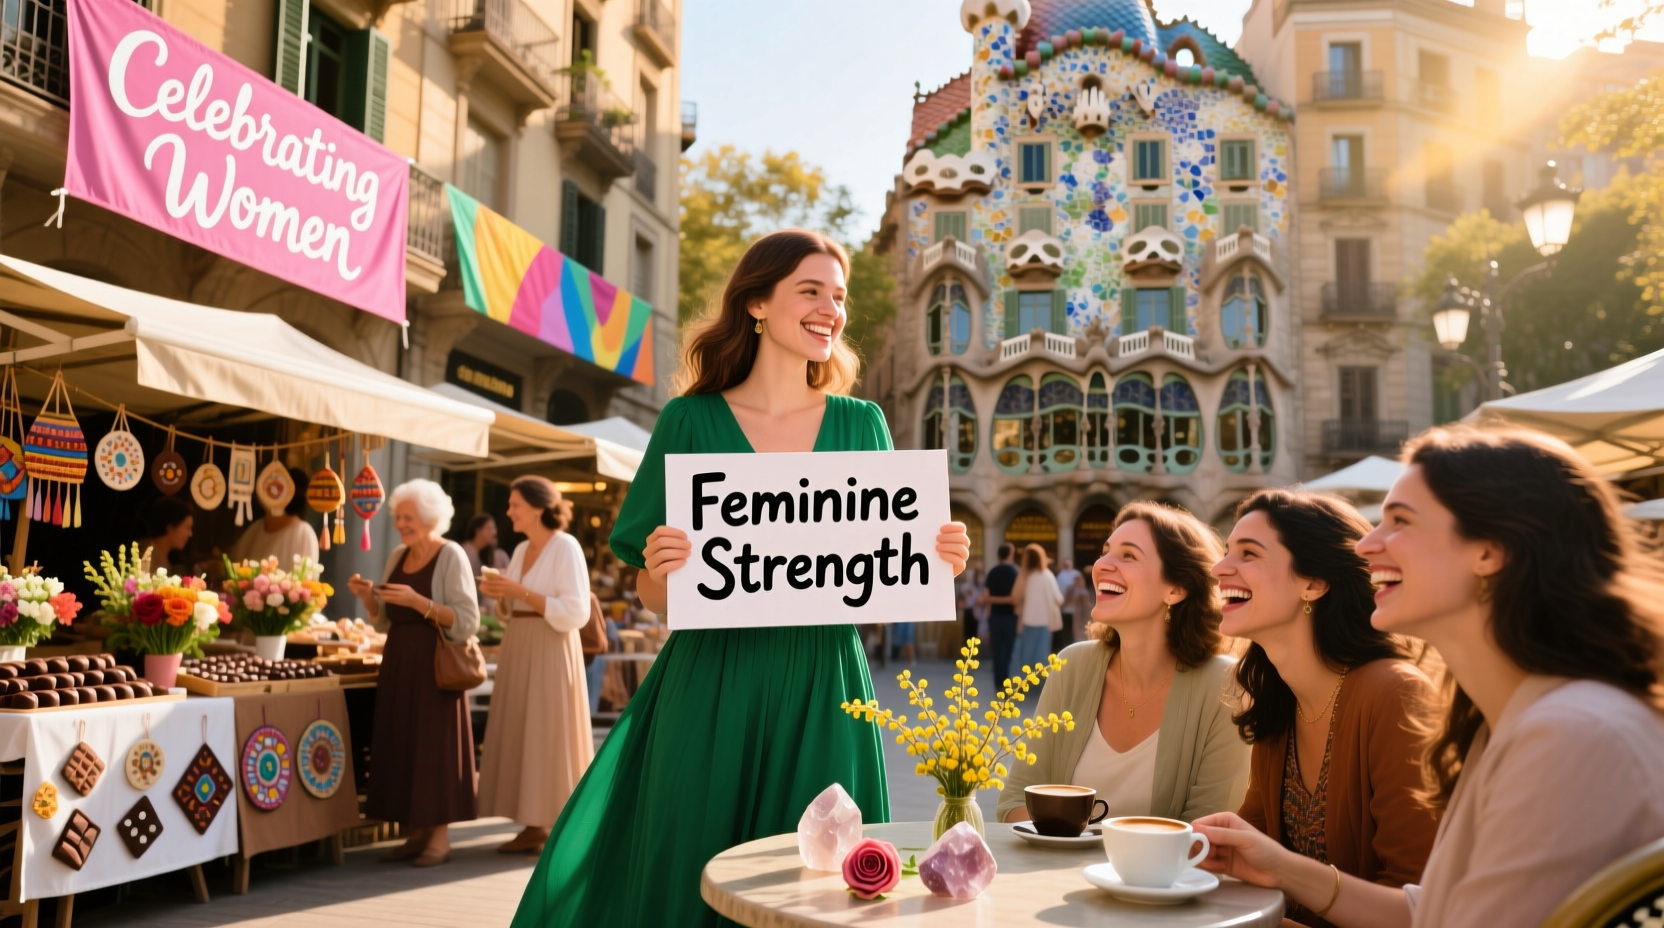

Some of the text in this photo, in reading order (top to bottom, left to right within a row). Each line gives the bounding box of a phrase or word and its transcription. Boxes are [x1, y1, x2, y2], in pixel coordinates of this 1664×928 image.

[108, 29, 380, 232] Celebrating
[143, 132, 363, 282] Women
[692, 471, 919, 531] Feminine
[696, 531, 930, 608] Strength
